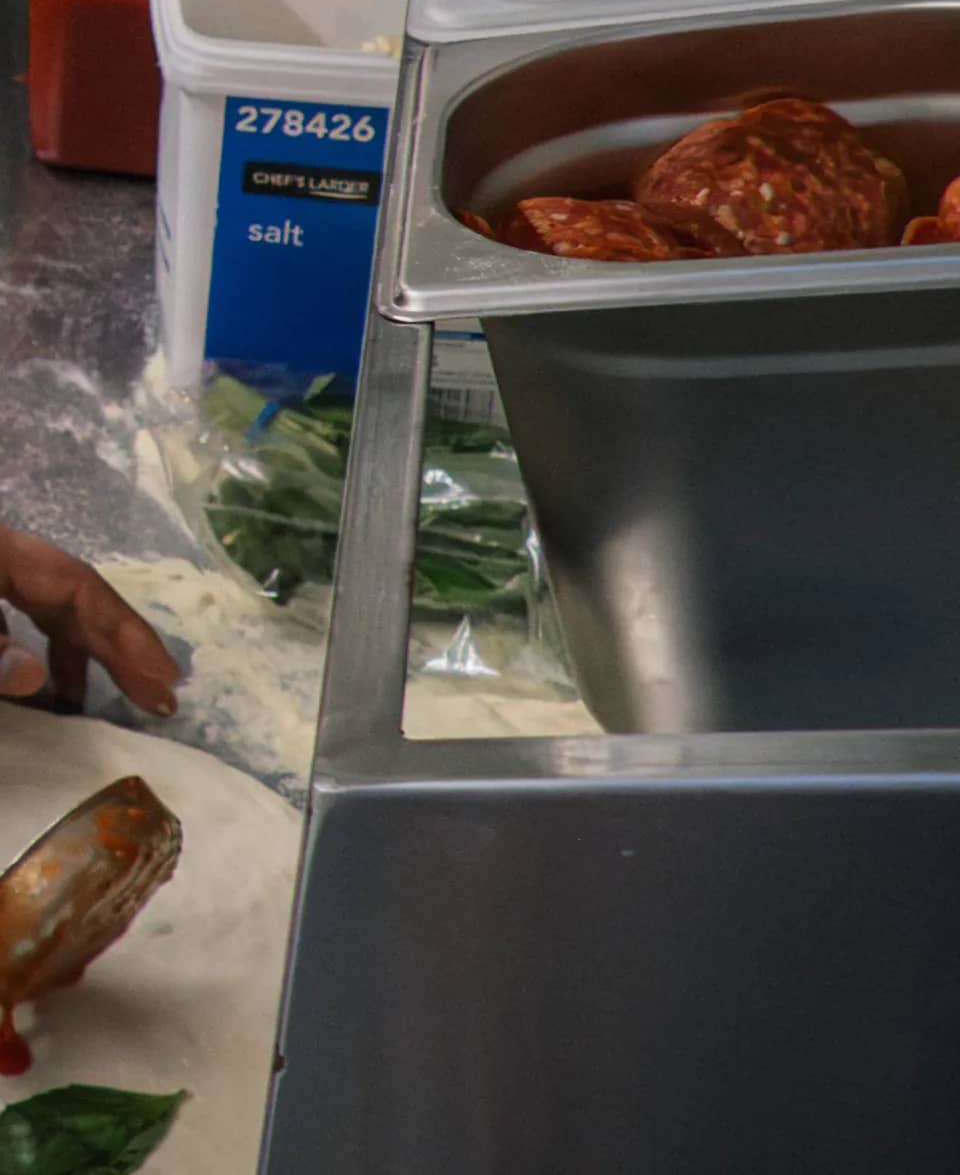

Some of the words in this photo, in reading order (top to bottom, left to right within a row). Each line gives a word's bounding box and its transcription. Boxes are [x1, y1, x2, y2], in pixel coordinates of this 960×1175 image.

[235, 105, 375, 142] 278426
[252, 171, 305, 188] CHEF'S
[247, 219, 304, 247] salt
